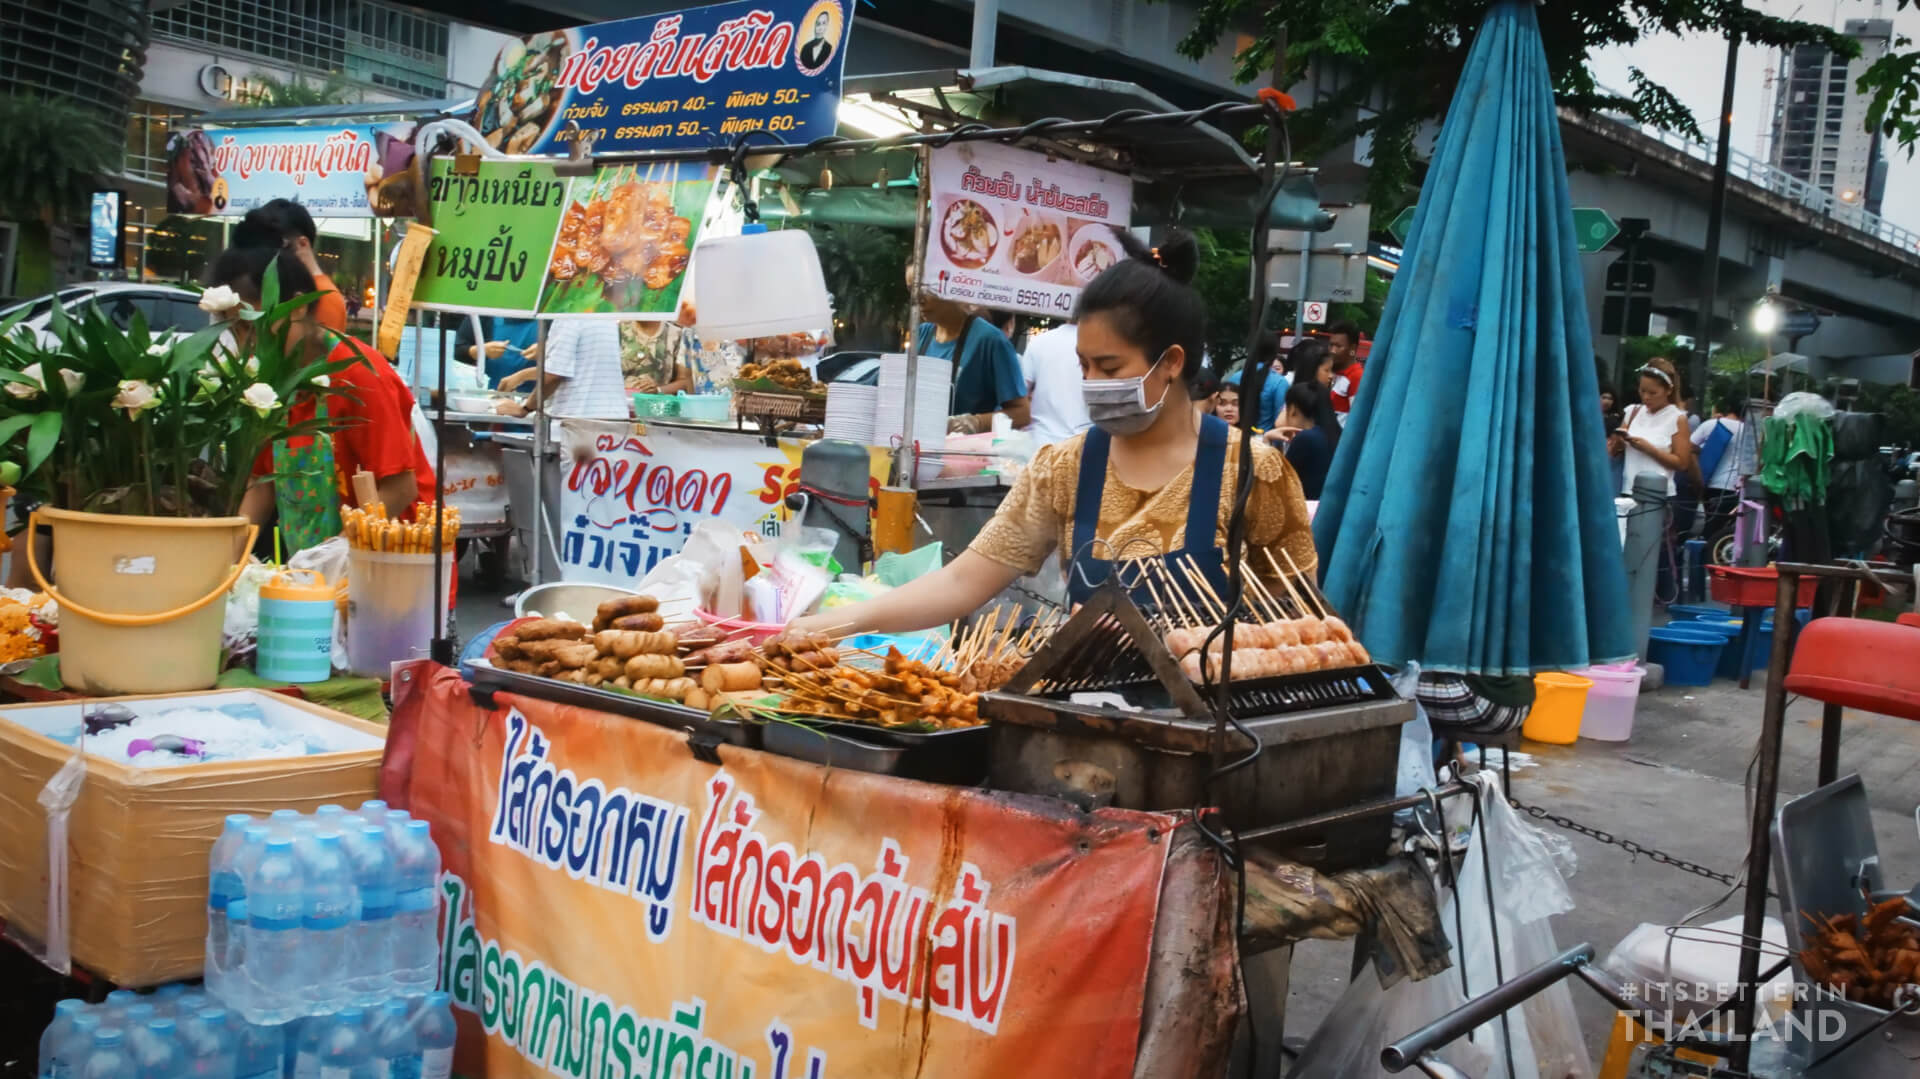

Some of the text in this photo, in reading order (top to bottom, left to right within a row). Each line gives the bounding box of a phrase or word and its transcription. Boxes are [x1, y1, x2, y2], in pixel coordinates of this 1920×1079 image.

[622, 99, 678, 117] ธรรมดา
[682, 97, 716, 113] 40.-
[725, 91, 769, 110] พิเศษ
[773, 88, 811, 105] 50.-
[614, 124, 672, 141] ธรรมดา
[676, 121, 710, 137] 50.-
[768, 115, 807, 132] 60.-
[432, 166, 564, 207] ข้าวเหนียว
[437, 224, 528, 291] หมูปิ้ง
[1054, 292, 1072, 311] 40
[567, 434, 733, 516] เจ๊นิดดา
[495, 715, 1009, 1023] ไส้กรอกหมู ไส้กรอกวุ้นเส้น
